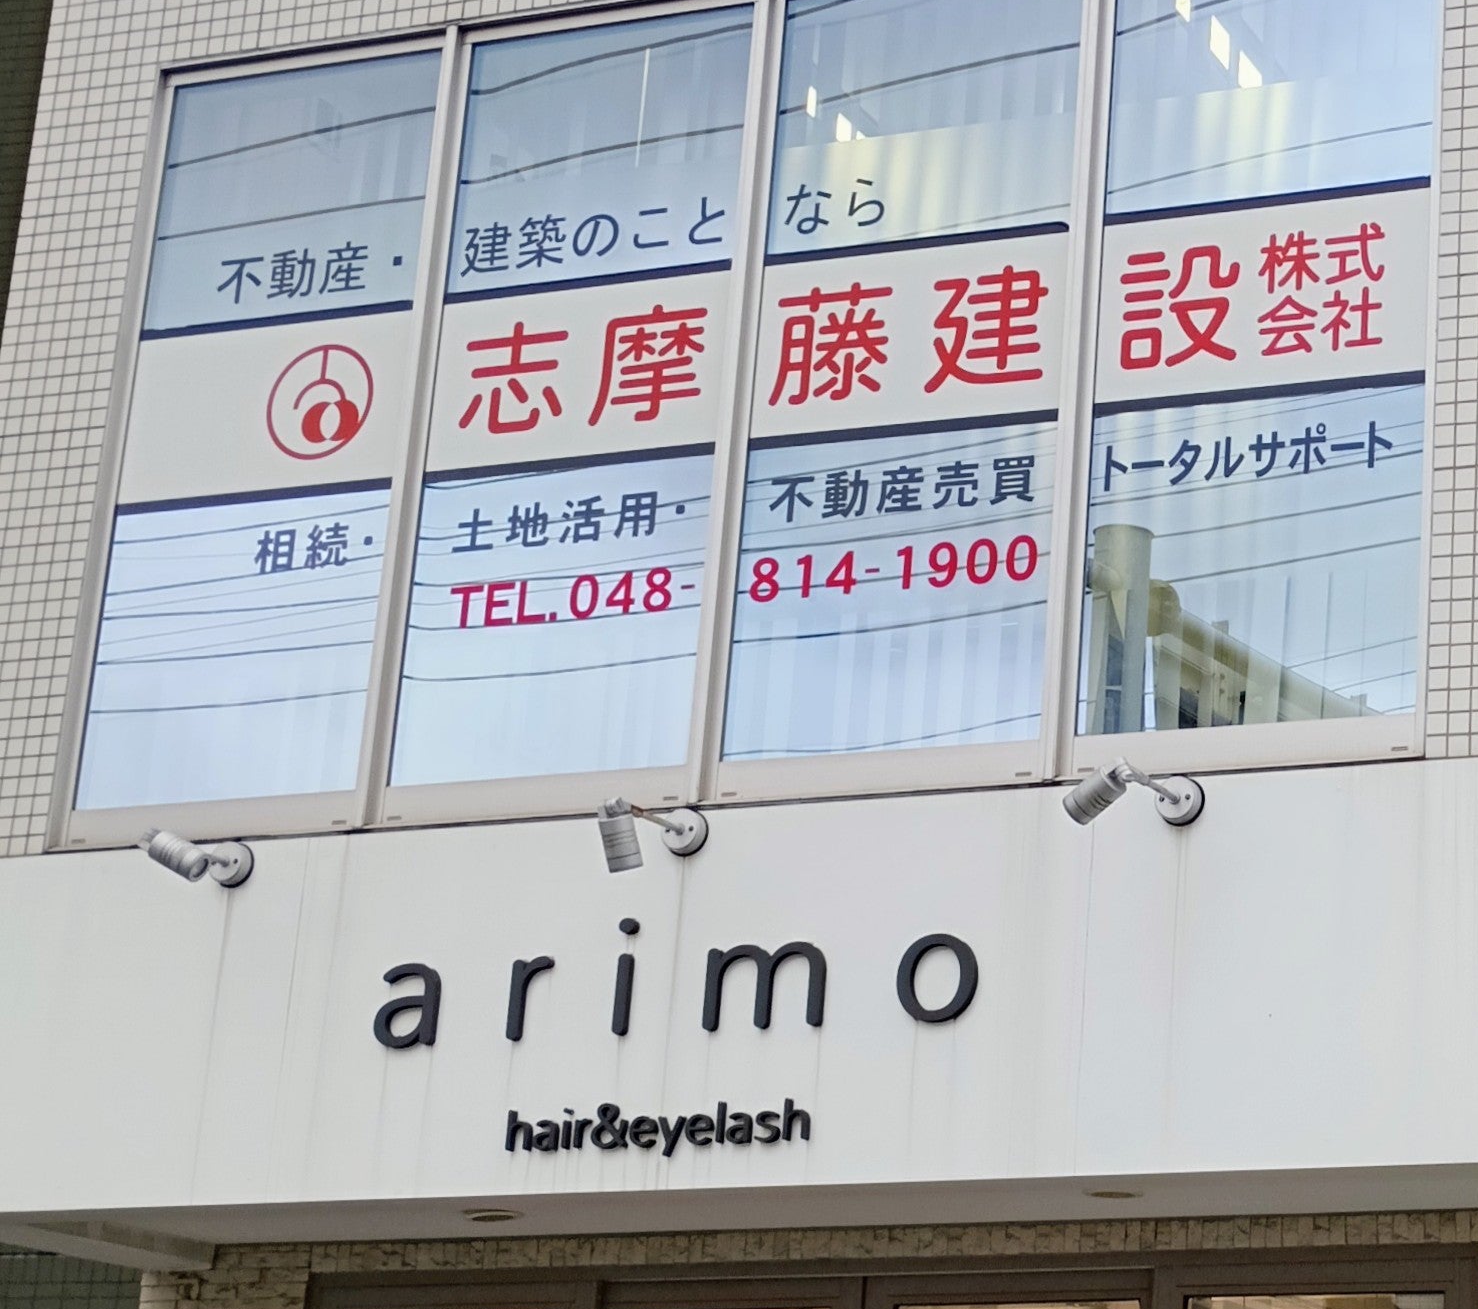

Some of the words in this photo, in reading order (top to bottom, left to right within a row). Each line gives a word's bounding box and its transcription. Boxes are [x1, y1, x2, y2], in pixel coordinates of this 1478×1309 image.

[460, 196, 725, 278] 建築のこと
[785, 178, 886, 235] なら
[769, 455, 1036, 523] 不動産売買
[1103, 421, 1394, 491] トータルサポート
[748, 534, 1039, 603] 814-1900
[372, 917, 979, 1049] arimo
[504, 1098, 812, 1158] hair&eyelash
